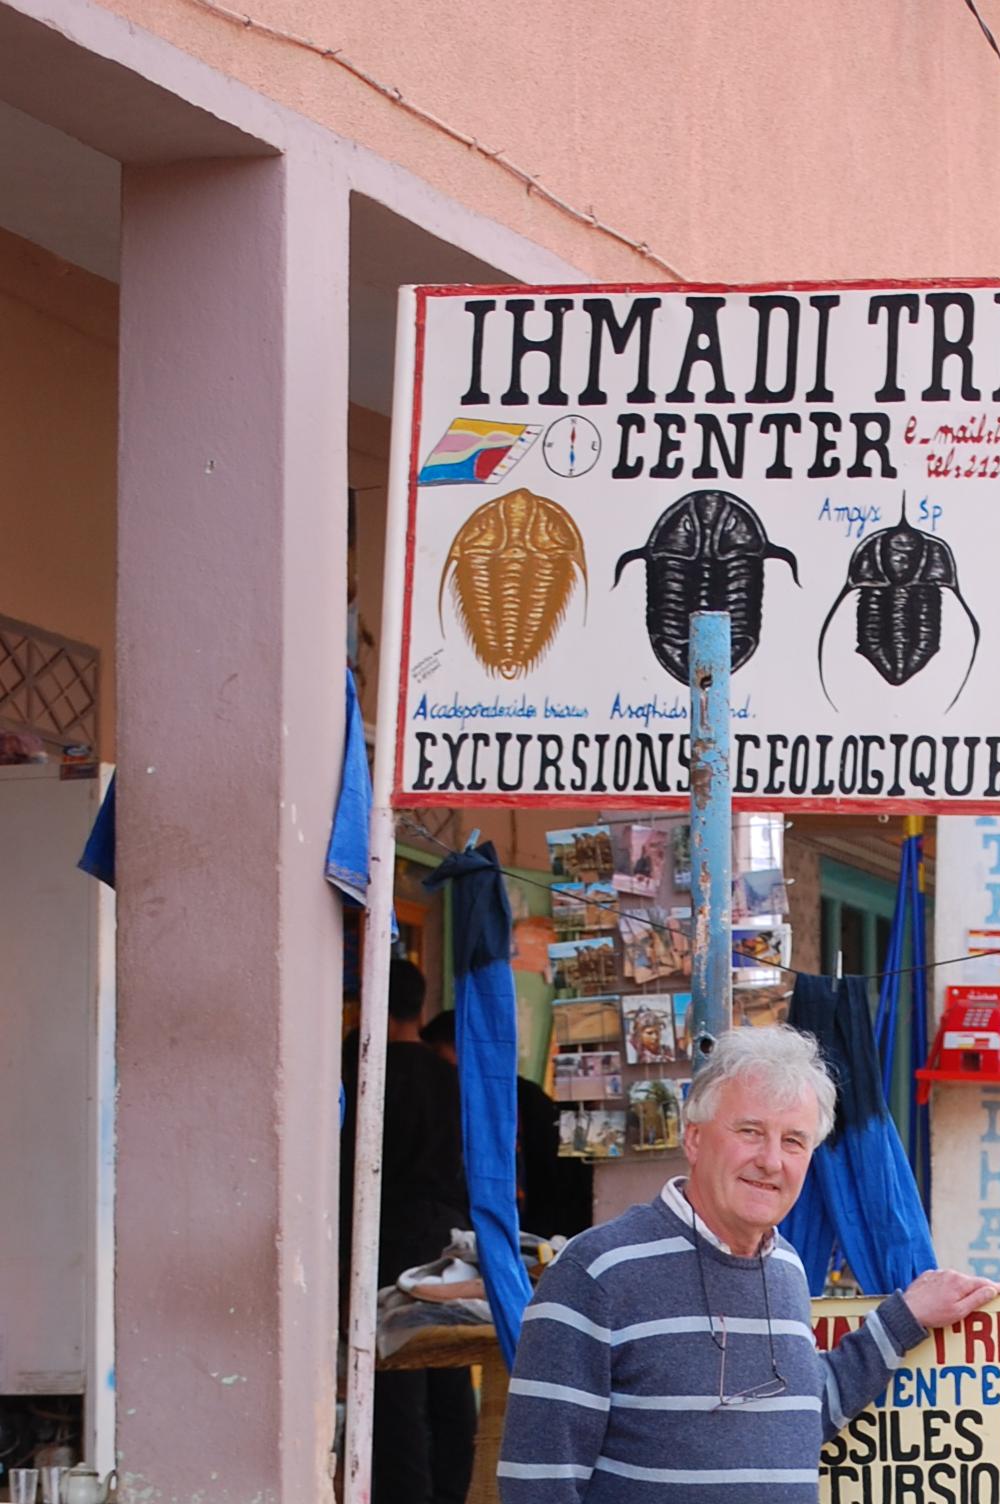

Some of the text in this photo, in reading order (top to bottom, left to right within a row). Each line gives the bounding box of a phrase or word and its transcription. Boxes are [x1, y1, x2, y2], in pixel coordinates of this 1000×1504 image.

[461, 295, 840, 405] IHMADI
[612, 412, 897, 479] CENTER
[412, 732, 691, 792] EXCURSIONS
[820, 1409, 984, 1466] SSILES
